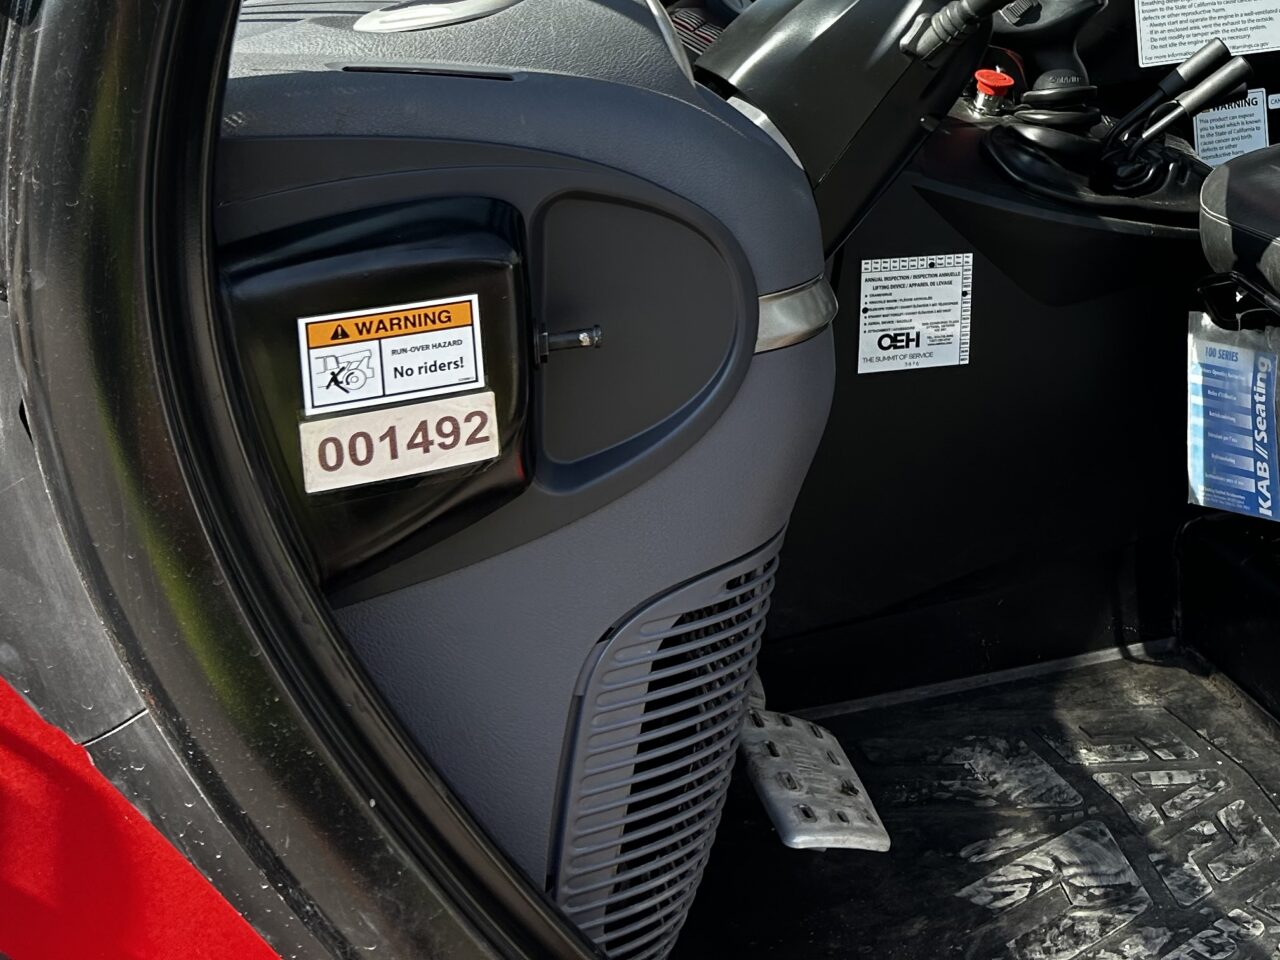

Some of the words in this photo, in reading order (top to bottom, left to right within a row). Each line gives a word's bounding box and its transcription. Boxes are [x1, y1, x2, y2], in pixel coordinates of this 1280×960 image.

[1271, 97, 1280, 105] CAN
[354, 309, 452, 336] WARNING
[391, 344, 430, 356] RUN-OVER
[432, 339, 463, 350] HAZARD
[877, 331, 921, 351] OEH
[1205, 346, 1217, 359] 100
[1218, 347, 1239, 363] SERIES
[393, 367, 413, 379] No
[417, 356, 465, 376] riders!
[1253, 355, 1272, 444] Seating
[318, 410, 491, 472] 001492
[1256, 461, 1273, 517] KAB
